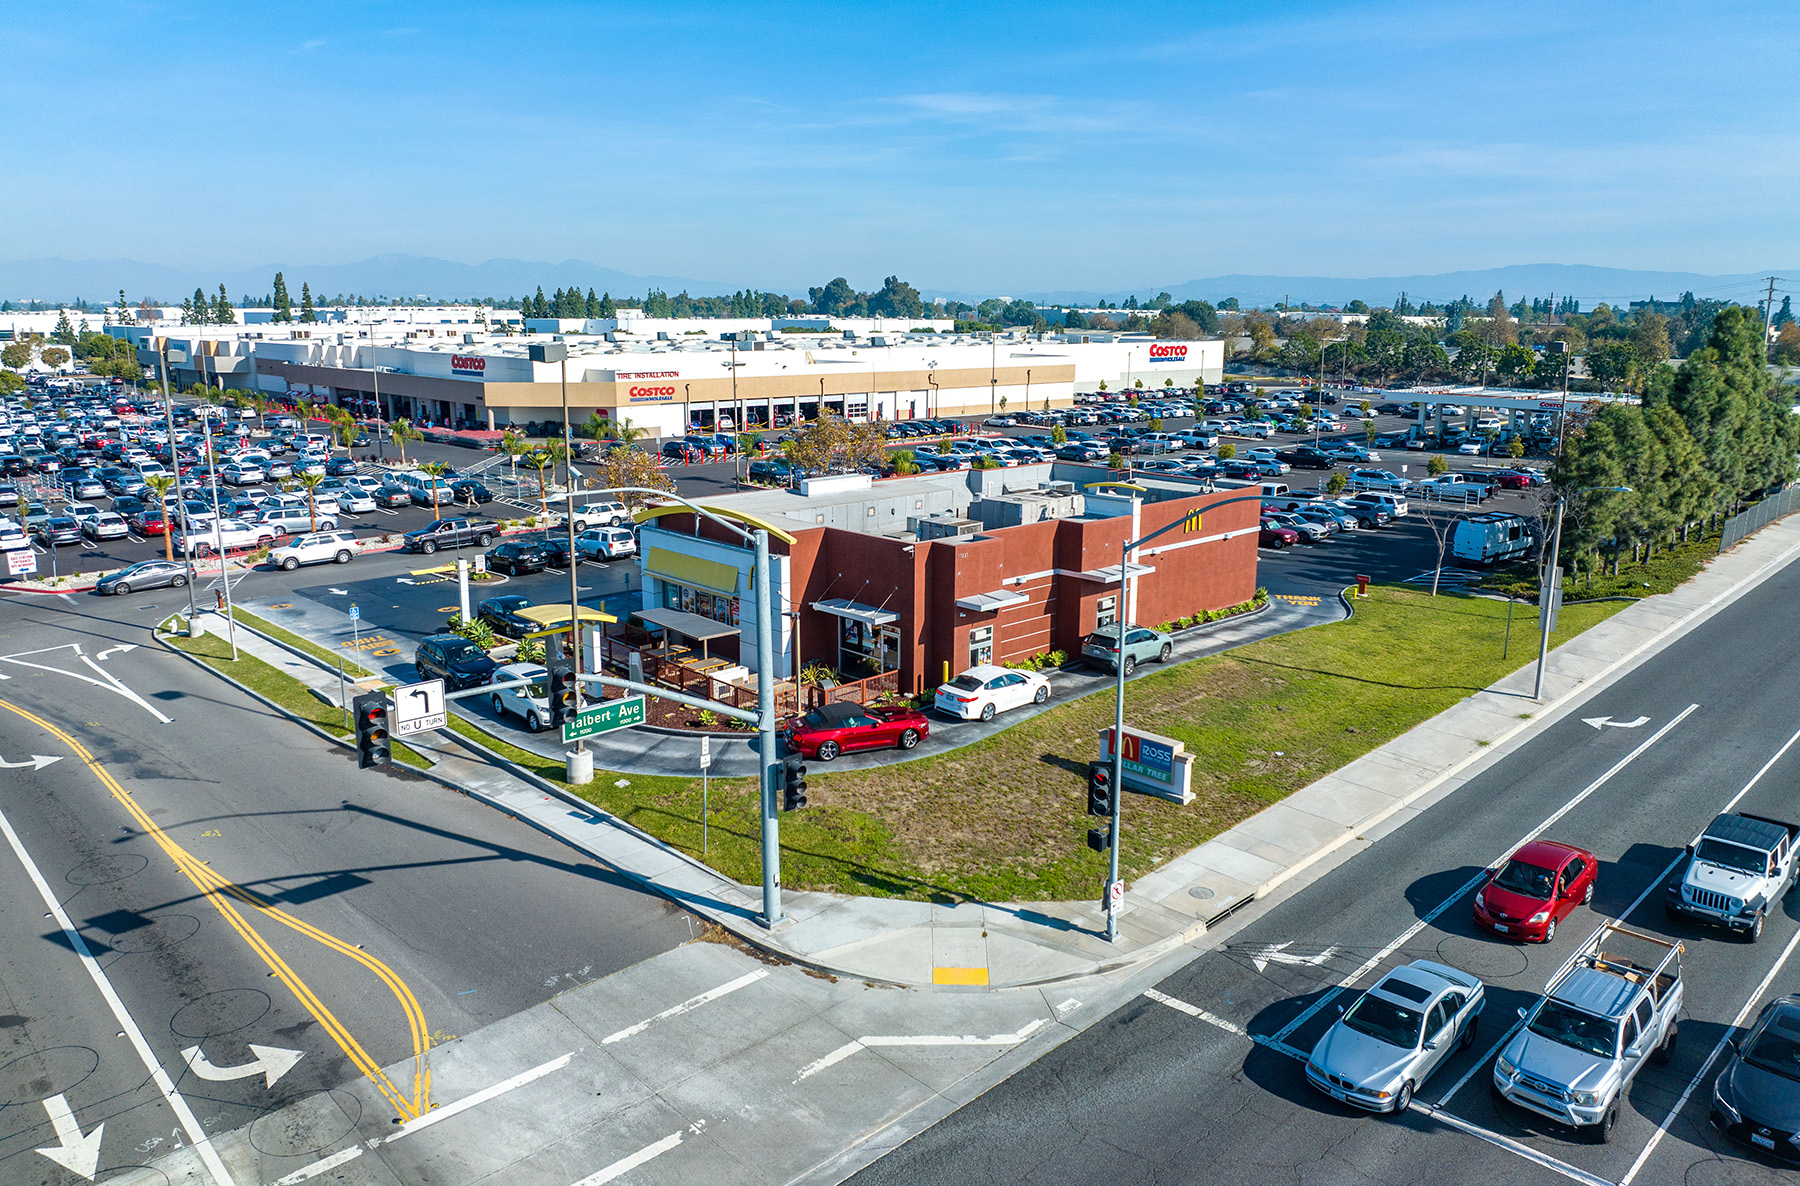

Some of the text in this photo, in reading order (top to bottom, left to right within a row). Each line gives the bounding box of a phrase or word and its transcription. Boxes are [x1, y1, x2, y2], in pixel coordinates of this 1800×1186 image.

[1149, 344, 1188, 357] COSTCO
[451, 354, 486, 371] COSTCO
[634, 371, 680, 379] INSTALLATION
[629, 386, 676, 398] COSTCO
[1275, 594, 1322, 602] THANK
[618, 704, 640, 718] Ave
[414, 720, 422, 729] U
[426, 717, 443, 726] TURN
[1142, 744, 1171, 762] ROSS
[1147, 768, 1168, 781] TREE
